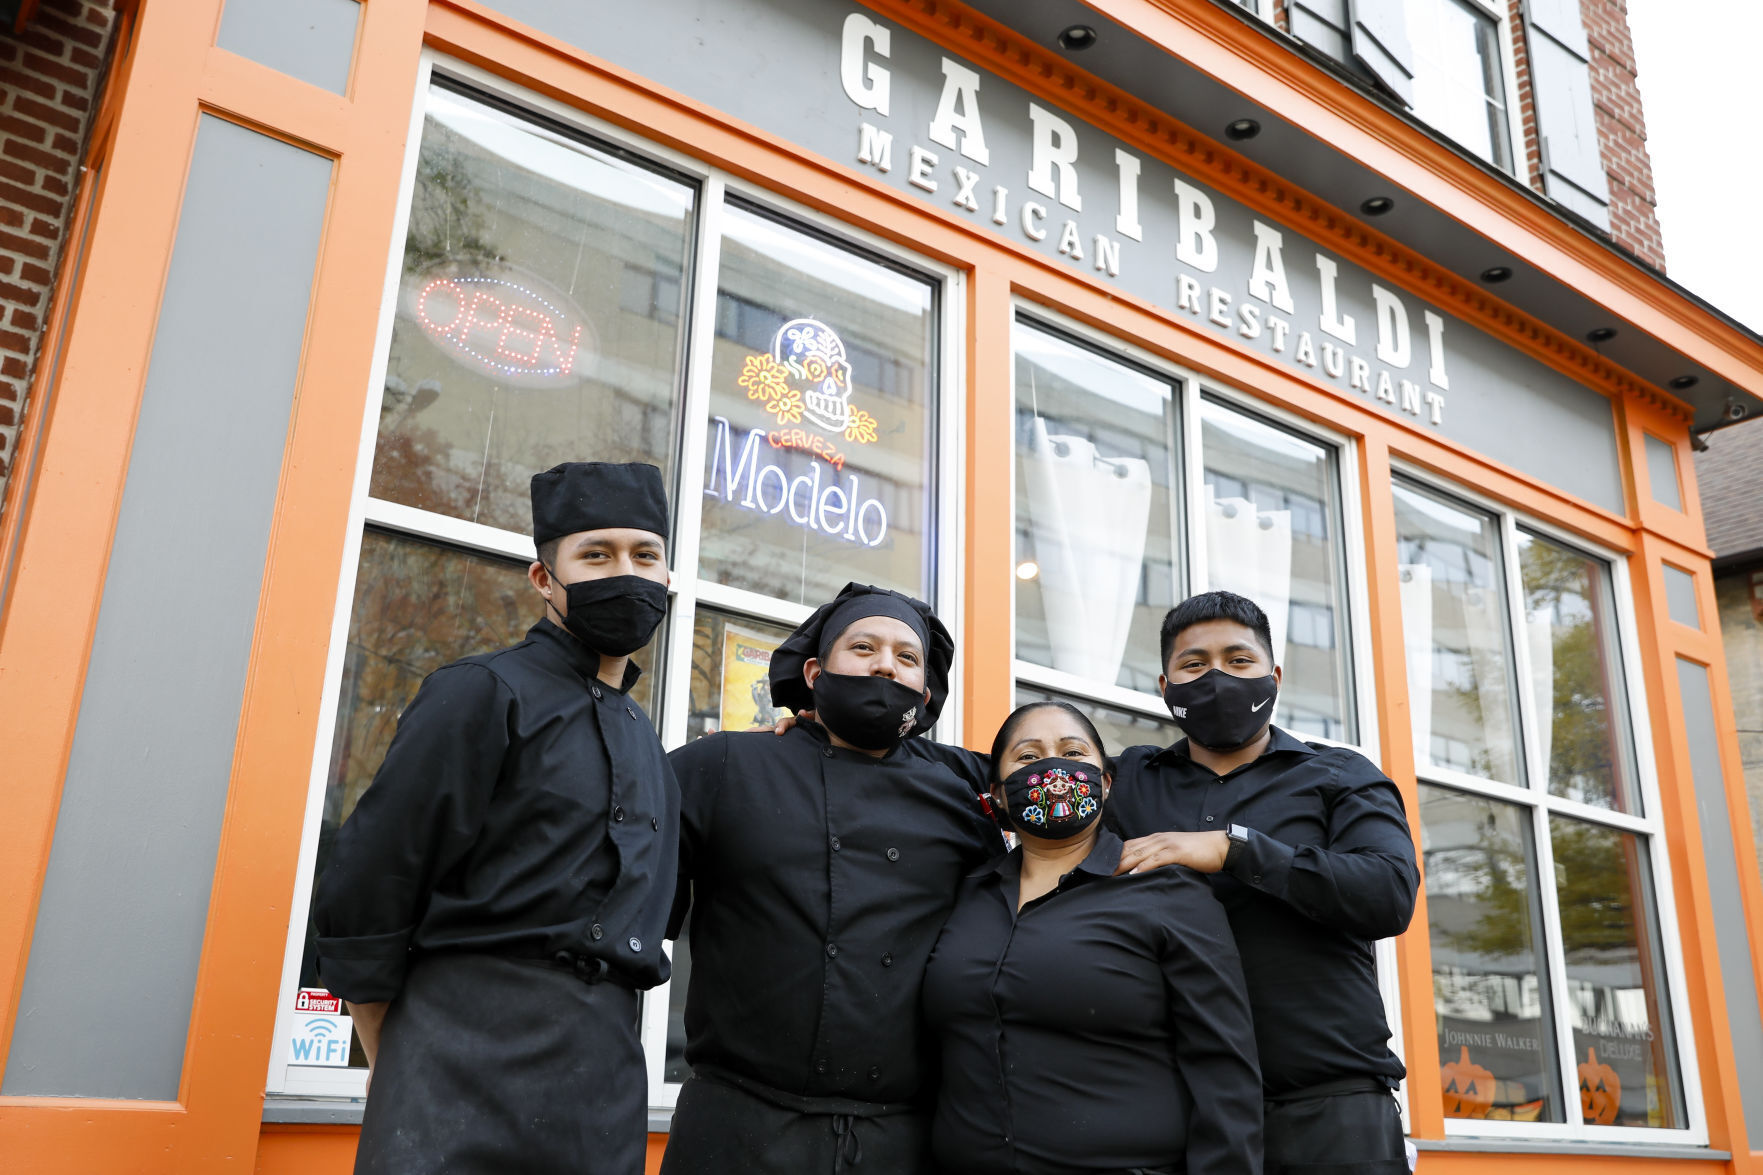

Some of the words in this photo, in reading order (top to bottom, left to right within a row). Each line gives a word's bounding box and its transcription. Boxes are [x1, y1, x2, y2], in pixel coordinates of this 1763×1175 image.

[841, 13, 1449, 391] GARIBALDI
[858, 122, 1121, 277] MEXICAN
[1177, 273, 1446, 426] RESTAURANT
[417, 278, 582, 375] OPEN
[767, 428, 847, 472] CERVEZA
[704, 415, 887, 547] Modelo
[1172, 705, 1188, 719] NIKE
[308, 1003, 335, 1012] SYSTEM
[309, 998, 338, 1008] SECURITY
[291, 1037, 347, 1062] WiFi
